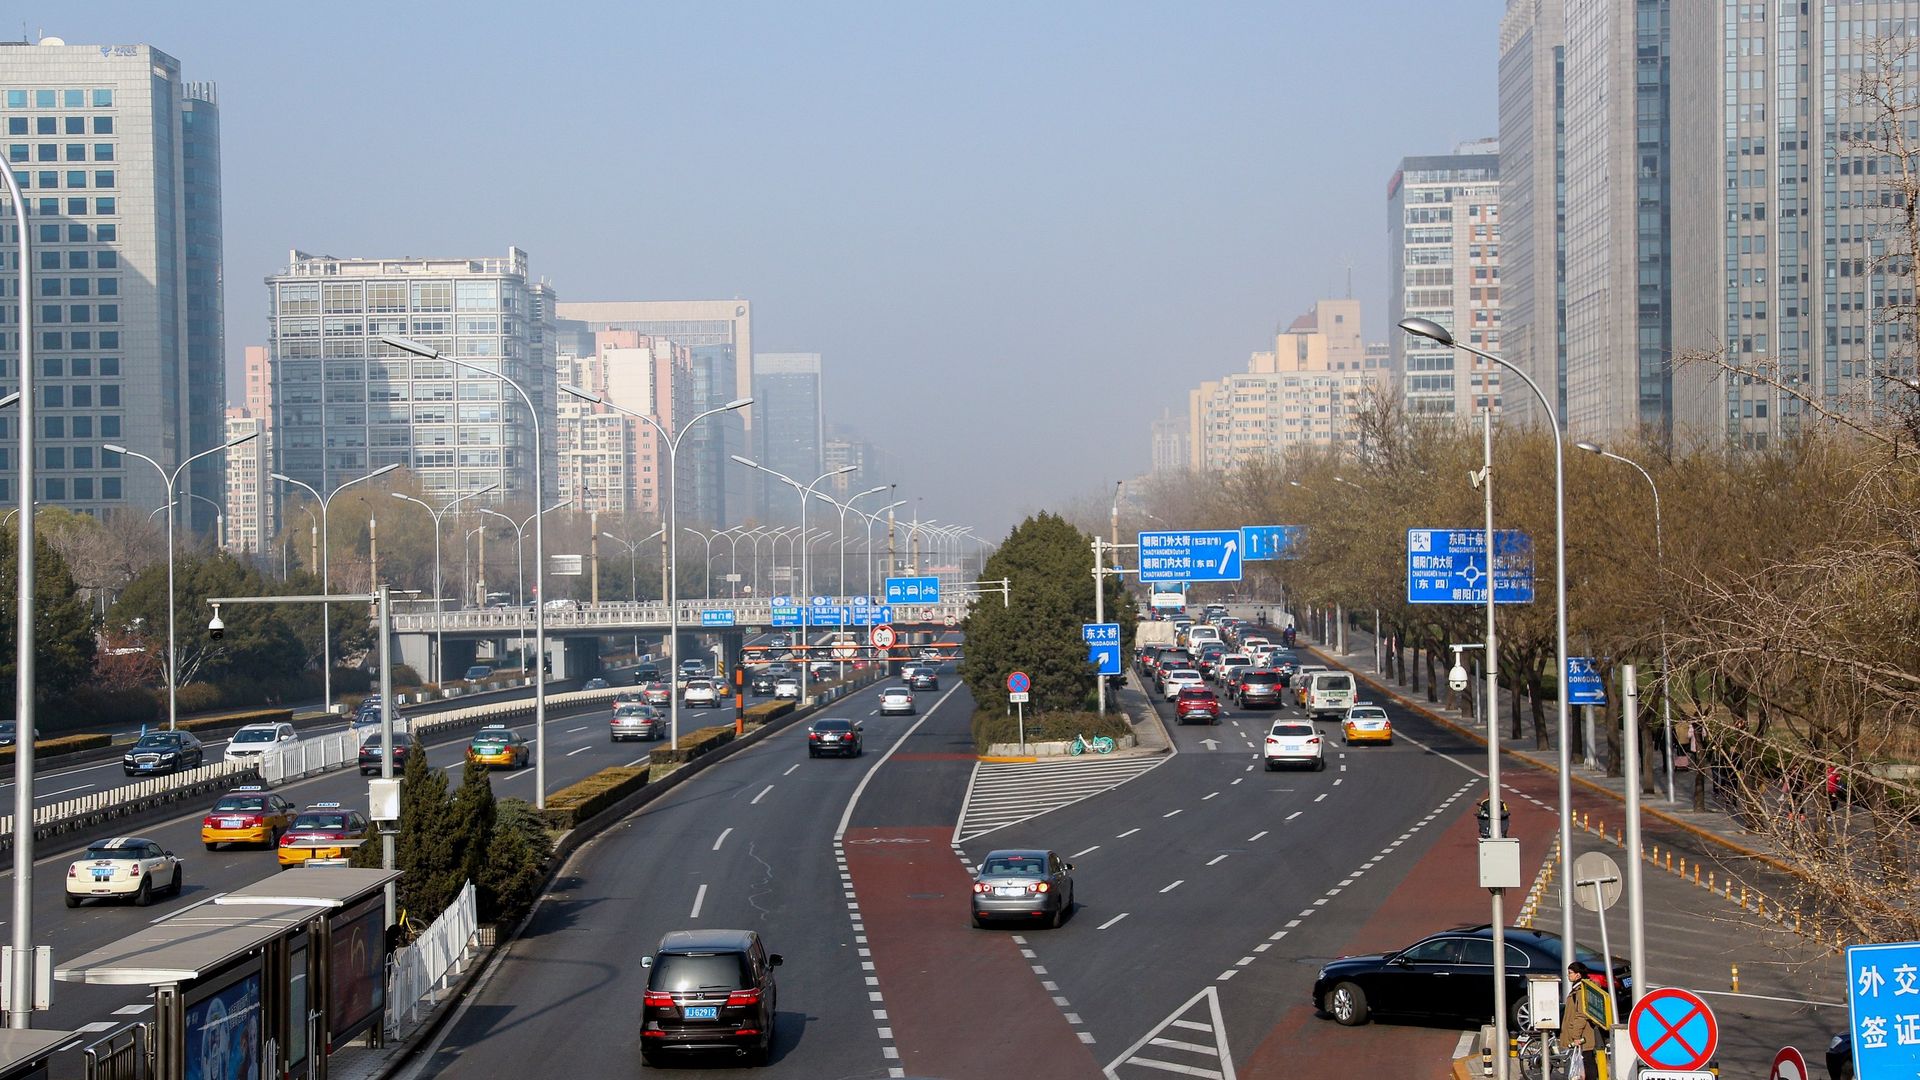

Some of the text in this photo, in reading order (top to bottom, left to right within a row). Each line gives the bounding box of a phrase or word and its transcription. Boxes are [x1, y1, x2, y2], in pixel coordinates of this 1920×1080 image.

[1142, 535, 1190, 547] 朝阳门外大街
[1413, 534, 1421, 543] 北
[1449, 533, 1487, 546] 东四十条
[1144, 557, 1190, 569] 朝阳门内大街
[1413, 556, 1453, 569] 朝阳门内大街
[877, 633, 890, 642] 3m
[1086, 628, 1117, 639] 东大桥
[1569, 660, 1594, 674] 东大
[1858, 963, 1919, 997] 外交
[1861, 1014, 1920, 1048] 签证
